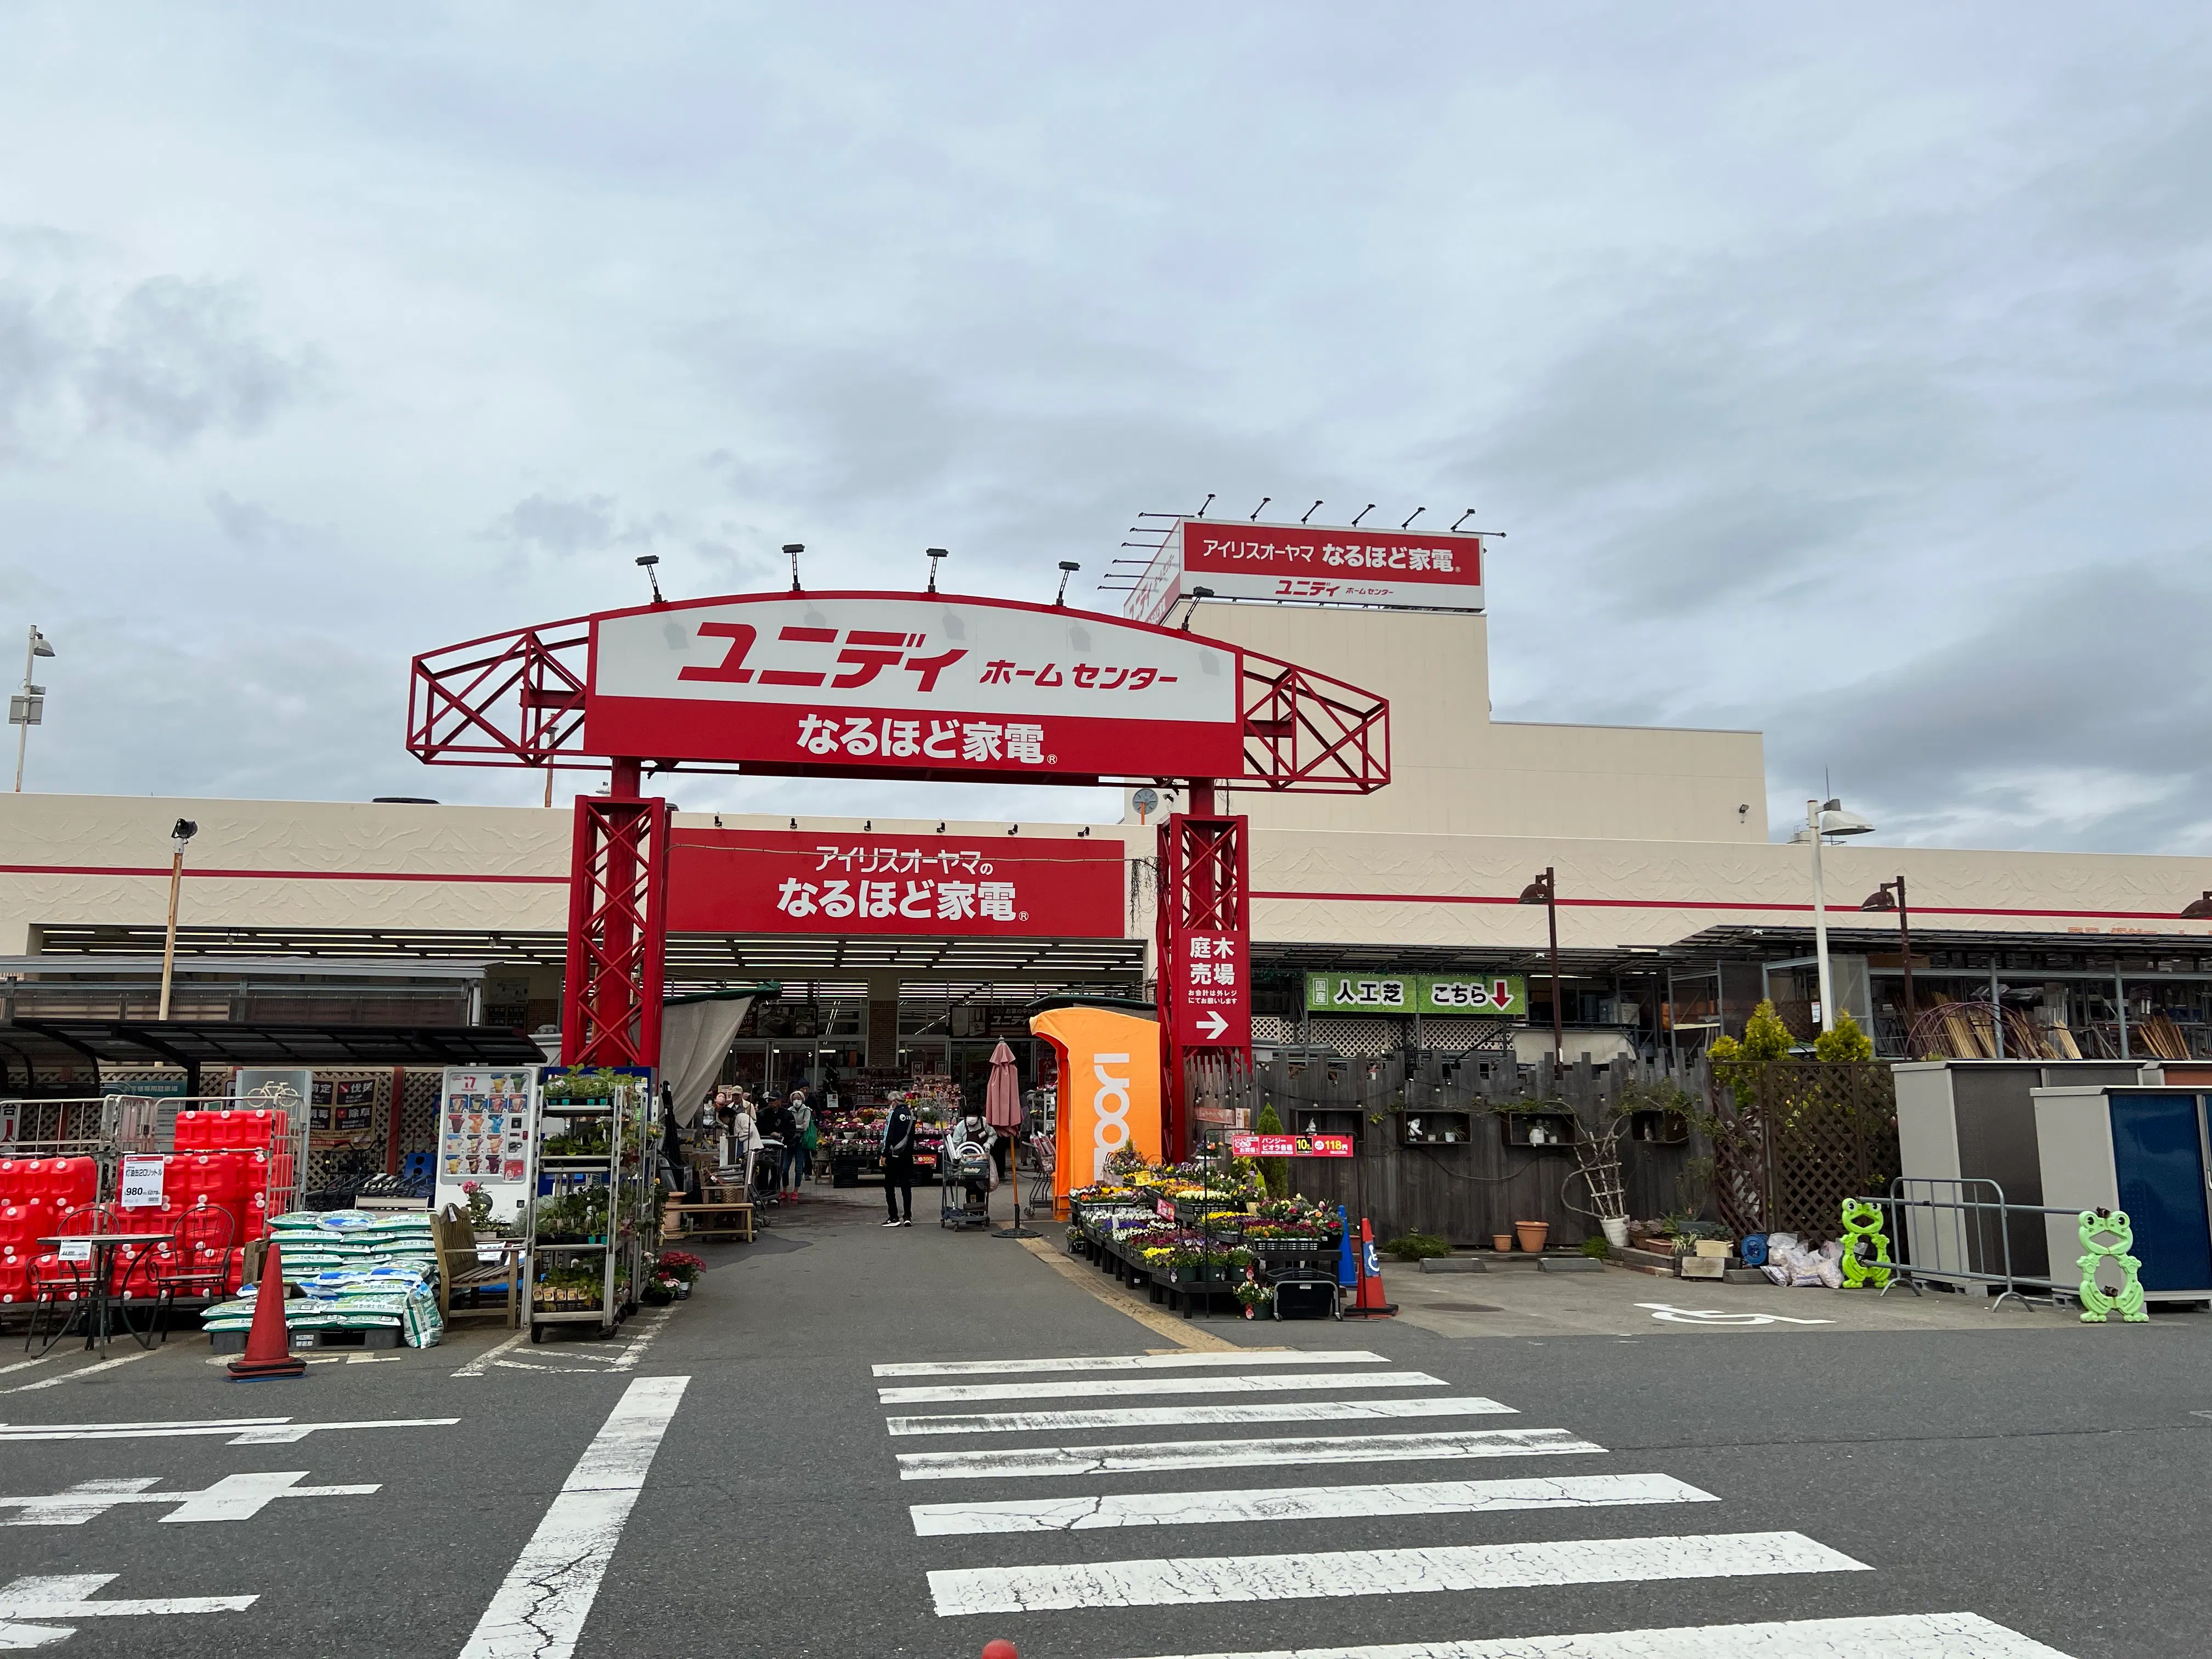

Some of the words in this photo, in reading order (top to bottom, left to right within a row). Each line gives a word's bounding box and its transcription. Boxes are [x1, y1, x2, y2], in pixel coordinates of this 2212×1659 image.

[1204, 540, 1314, 562] アイリスオーヤマ
[1276, 580, 1340, 596] ユニディ
[1346, 587, 1393, 596] ホームセンター
[678, 622, 968, 692] ユニディ
[980, 659, 1177, 690] ホームセンター
[816, 846, 994, 876] アイリスオーヤマの
[1189, 936, 1234, 959] 庭木
[1190, 962, 1235, 985] 売場
[1314, 979, 1328, 1004] 国産
[1336, 981, 1402, 1003] 人工芝
[1433, 985, 1487, 1003] こちら
[126, 1187, 143, 1195] 980
